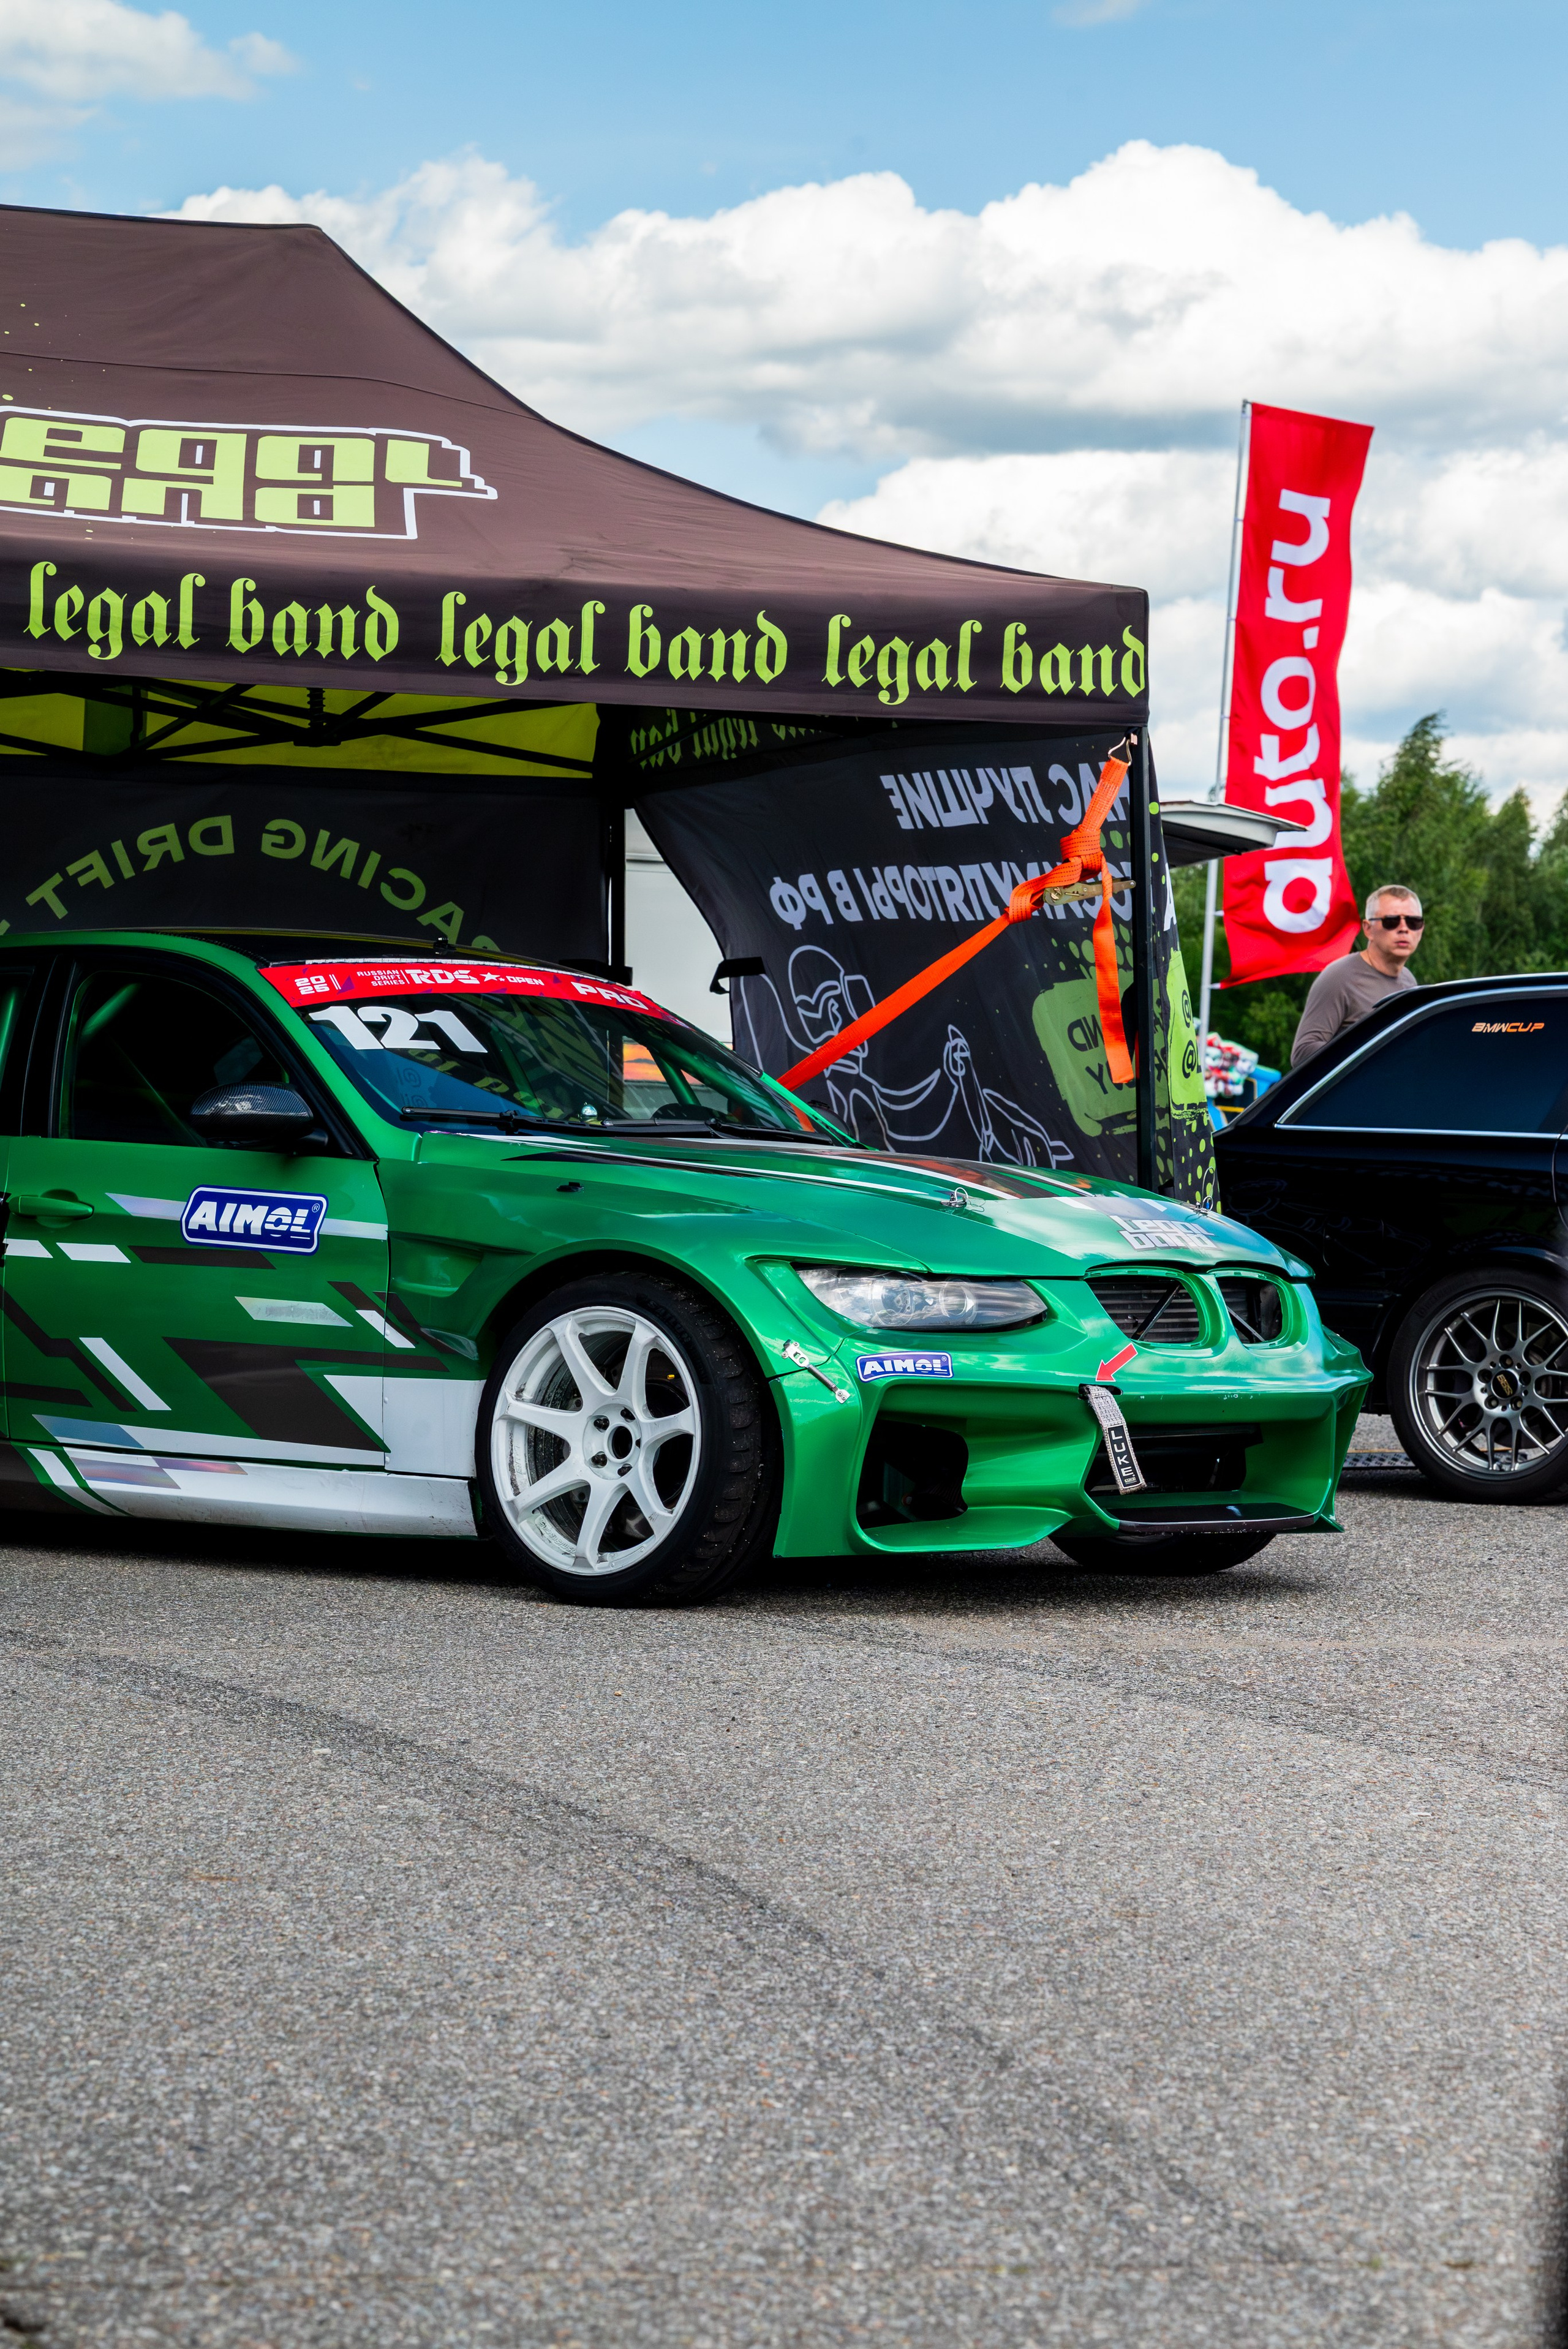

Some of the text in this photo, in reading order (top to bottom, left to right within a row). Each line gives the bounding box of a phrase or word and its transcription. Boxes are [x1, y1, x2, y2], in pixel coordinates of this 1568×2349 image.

[0, 417, 462, 487] egal
[0, 464, 375, 527] and
[23, 561, 1145, 706] legal band legal band legal band
[1254, 489, 1333, 933] auto.ru
[405, 969, 545, 986] RDS OPEN
[570, 981, 649, 1011] PRO
[308, 1006, 488, 1054] 121
[1496, 1374, 1513, 1396] BBS
